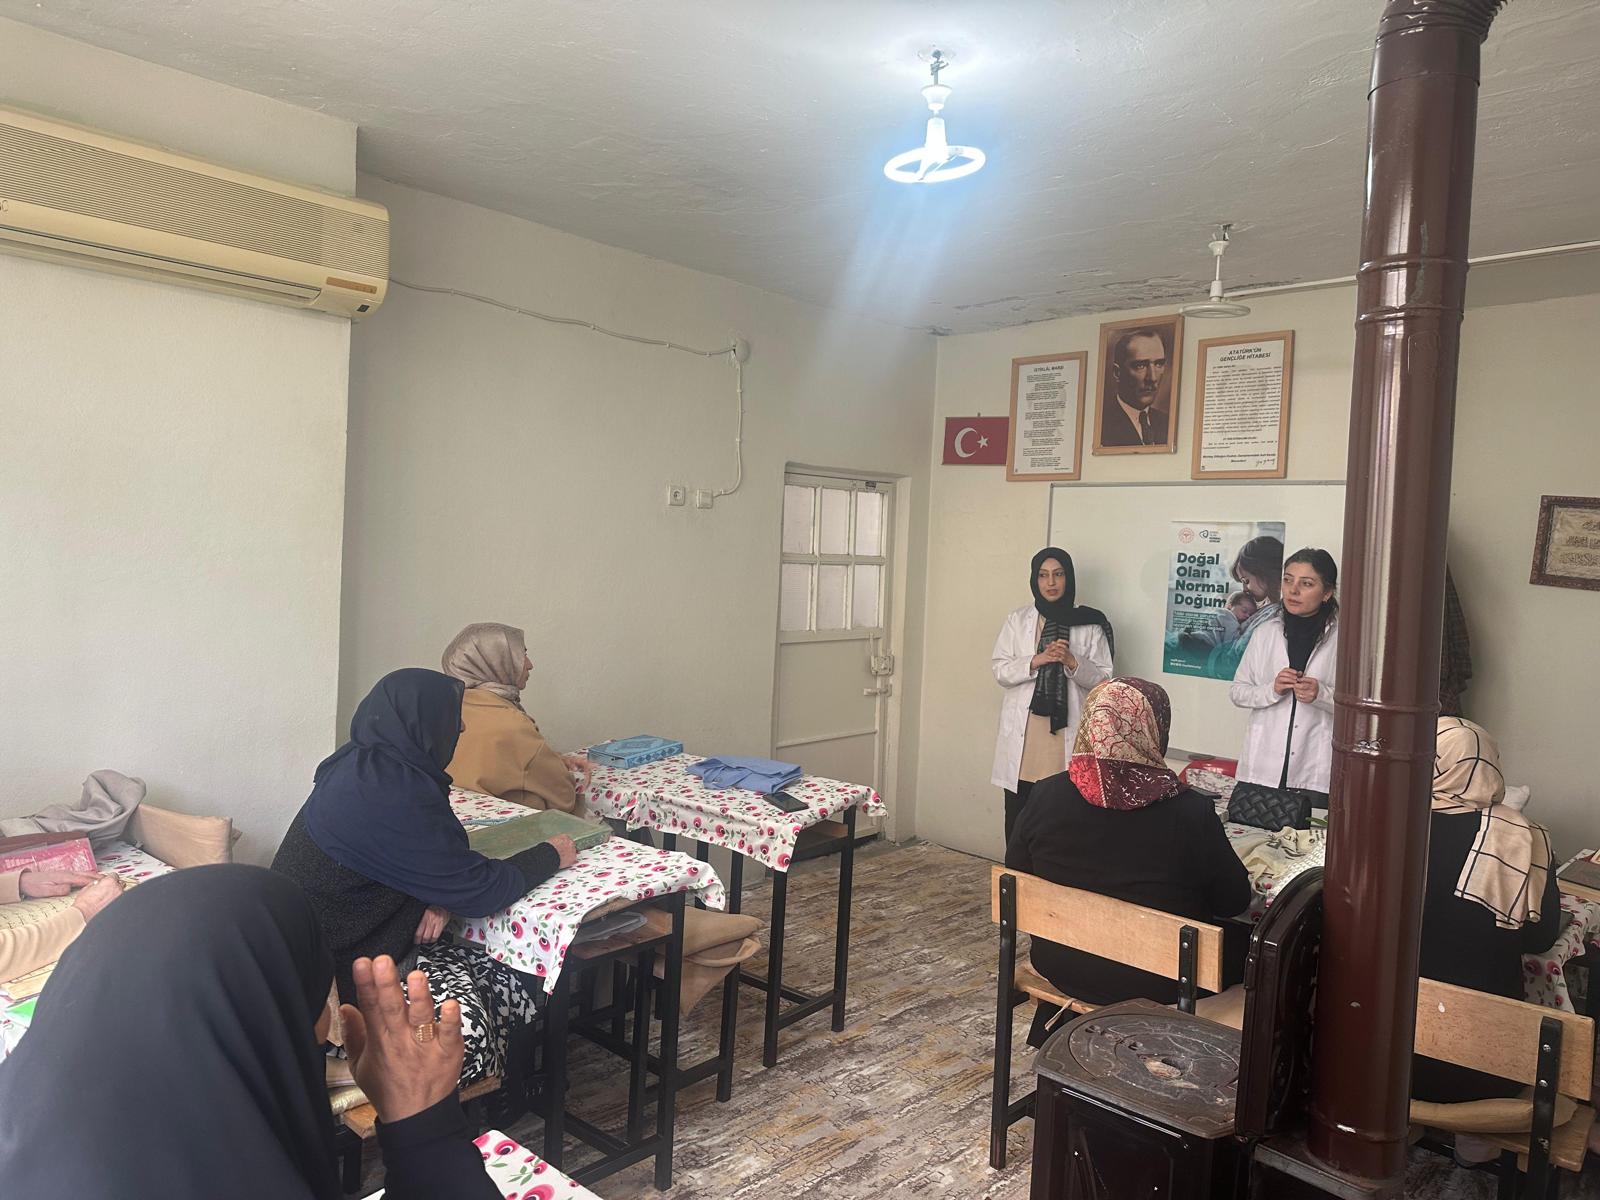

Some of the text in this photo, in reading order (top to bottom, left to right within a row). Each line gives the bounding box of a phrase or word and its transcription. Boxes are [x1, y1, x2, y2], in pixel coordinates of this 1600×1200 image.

[1219, 351, 1272, 362] GENÇLİĞE HİTABESİ
[1228, 347, 1262, 356] ATATÜRK'ÜN
[1177, 552, 1220, 567] Doğal
[1176, 566, 1211, 578] Olan
[1175, 580, 1229, 594] Normal
[1174, 593, 1227, 609] Doğum
